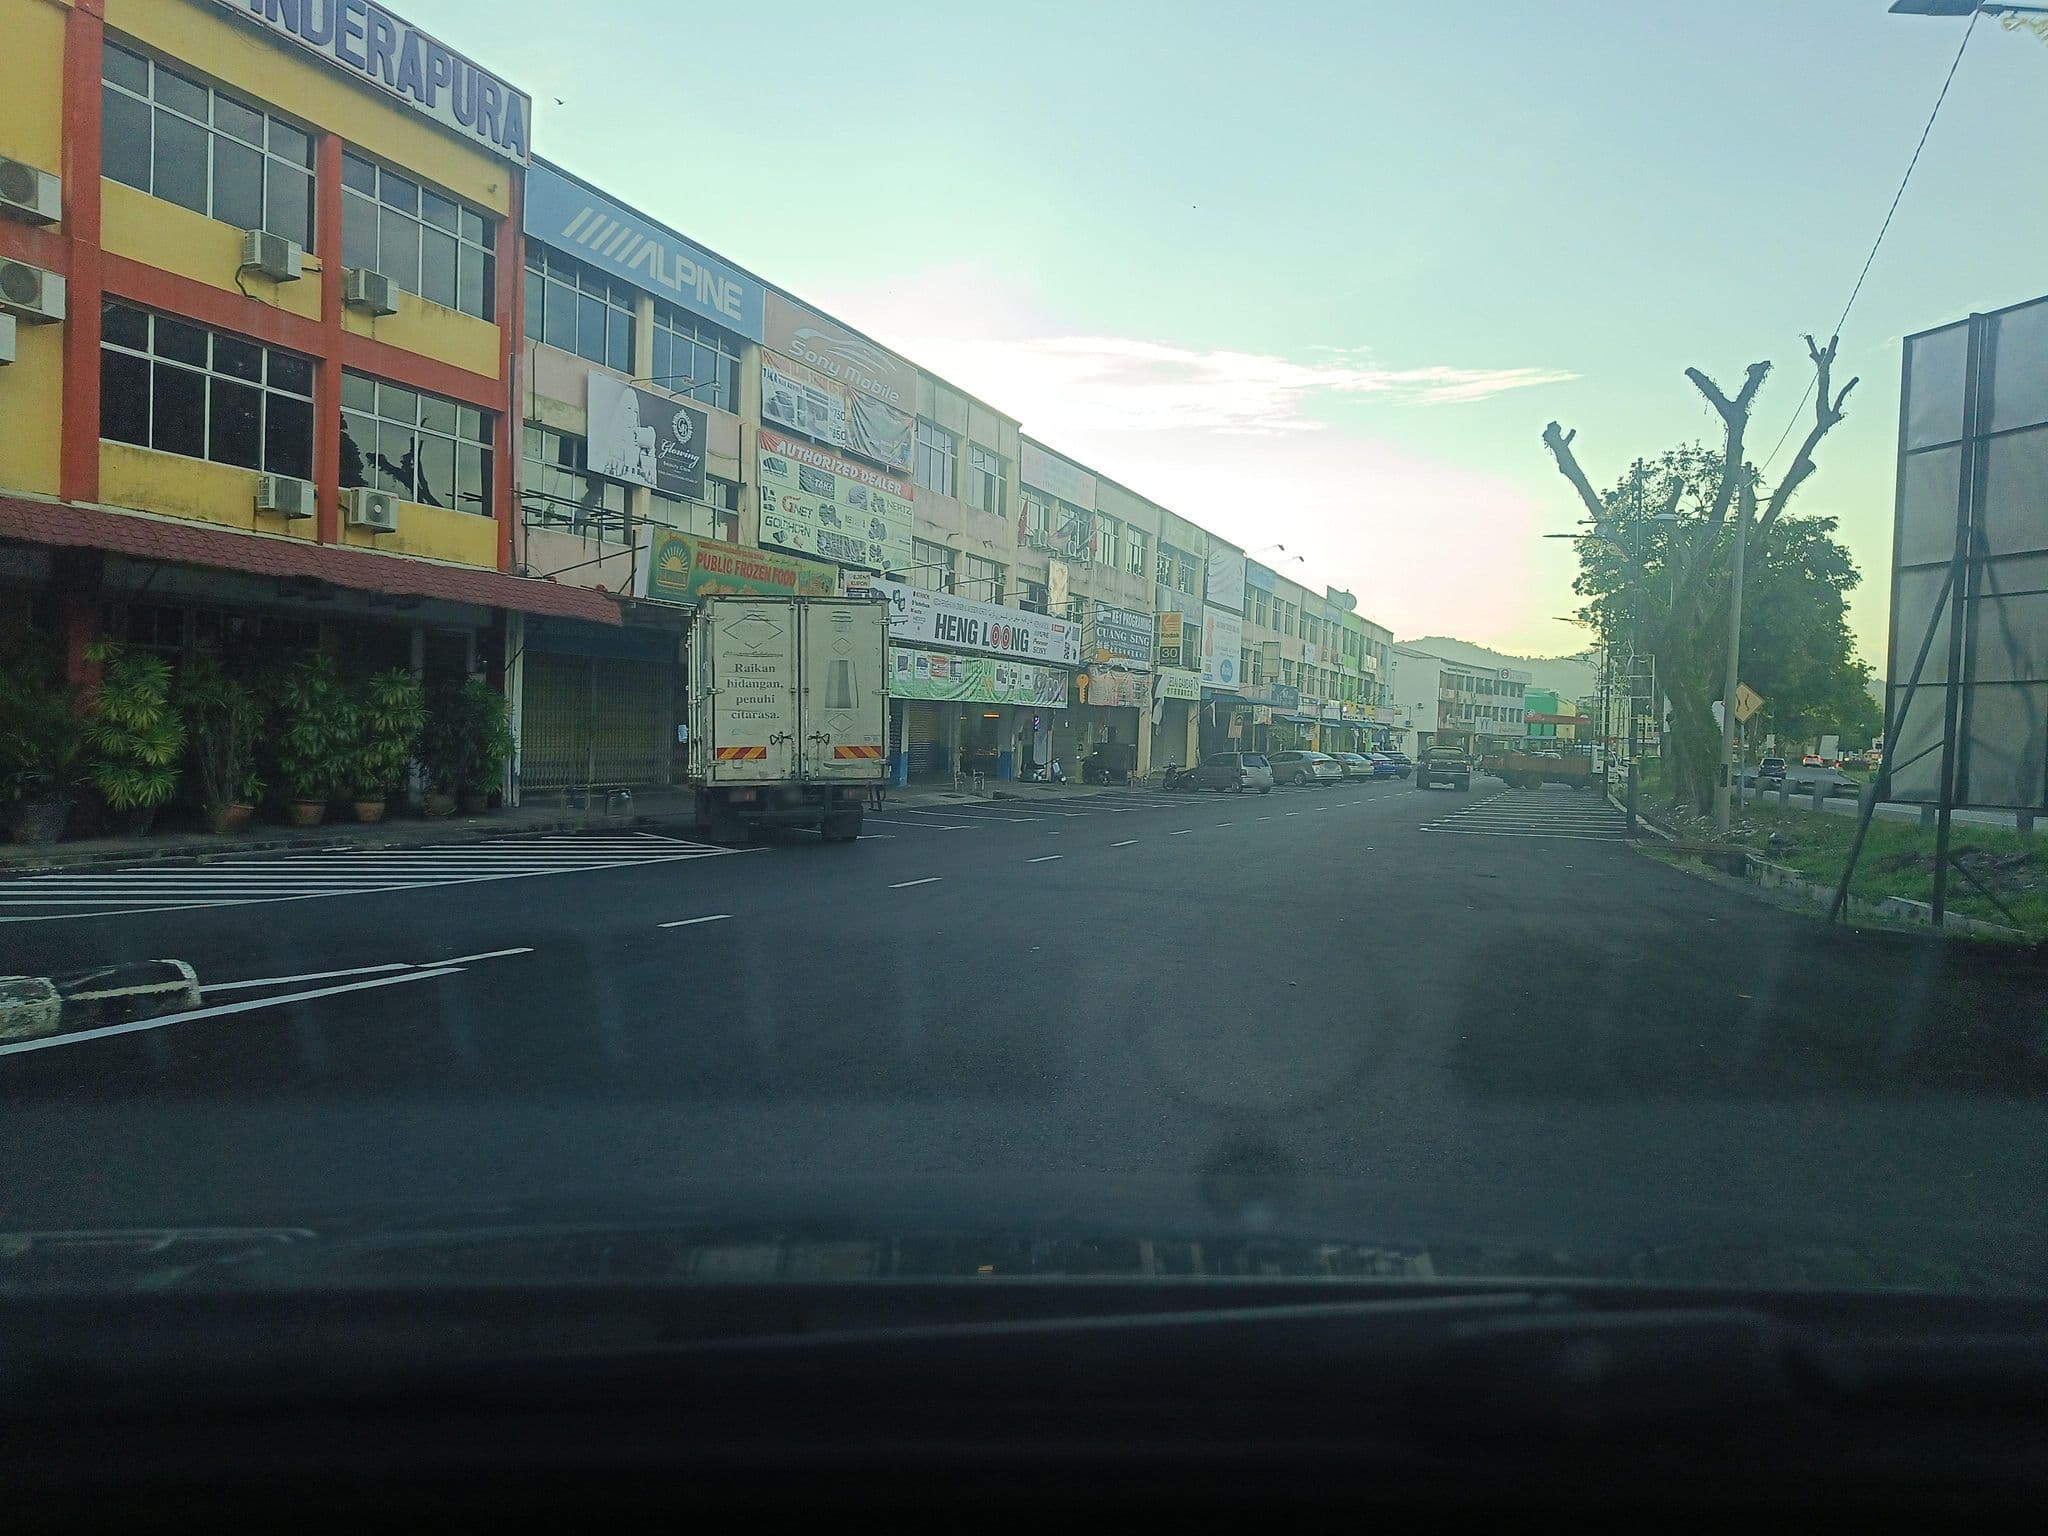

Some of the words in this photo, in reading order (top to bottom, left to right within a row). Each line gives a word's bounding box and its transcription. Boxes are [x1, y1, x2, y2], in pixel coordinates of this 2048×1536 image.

[250, 0, 527, 158] DERAPURA
[659, 439, 700, 469] Glowing
[776, 441, 859, 477] AUTHORIZED
[862, 469, 902, 495] DEALER
[696, 551, 733, 574] PUBLIC
[735, 560, 771, 582] FROZEN
[772, 567, 797, 587] FOOD
[934, 613, 978, 644] HENG
[982, 622, 1029, 652] LOONG
[1097, 627, 1126, 641] CUANG
[1130, 634, 1149, 646] SING
[1162, 647, 1178, 658] 30
[734, 663, 776, 673] Raikan
[736, 694, 775, 705] penuhi
[731, 710, 780, 719] citarasa.
